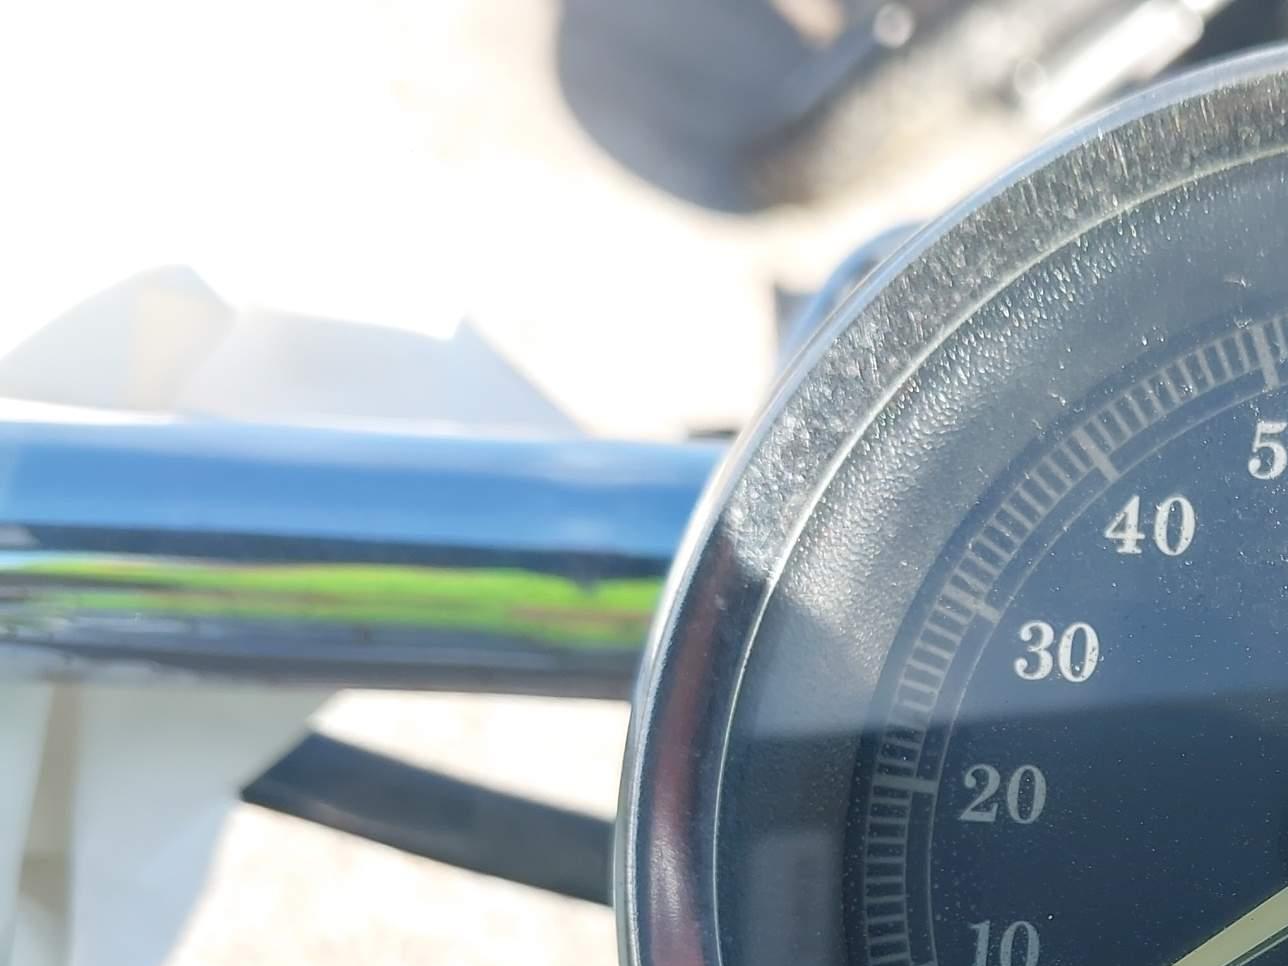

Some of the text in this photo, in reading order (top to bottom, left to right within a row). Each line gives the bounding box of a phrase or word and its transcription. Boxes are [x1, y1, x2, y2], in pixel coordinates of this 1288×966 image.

[1103, 494, 1197, 557] 40
[1013, 619, 1100, 684] 30
[958, 764, 1047, 824] 20
